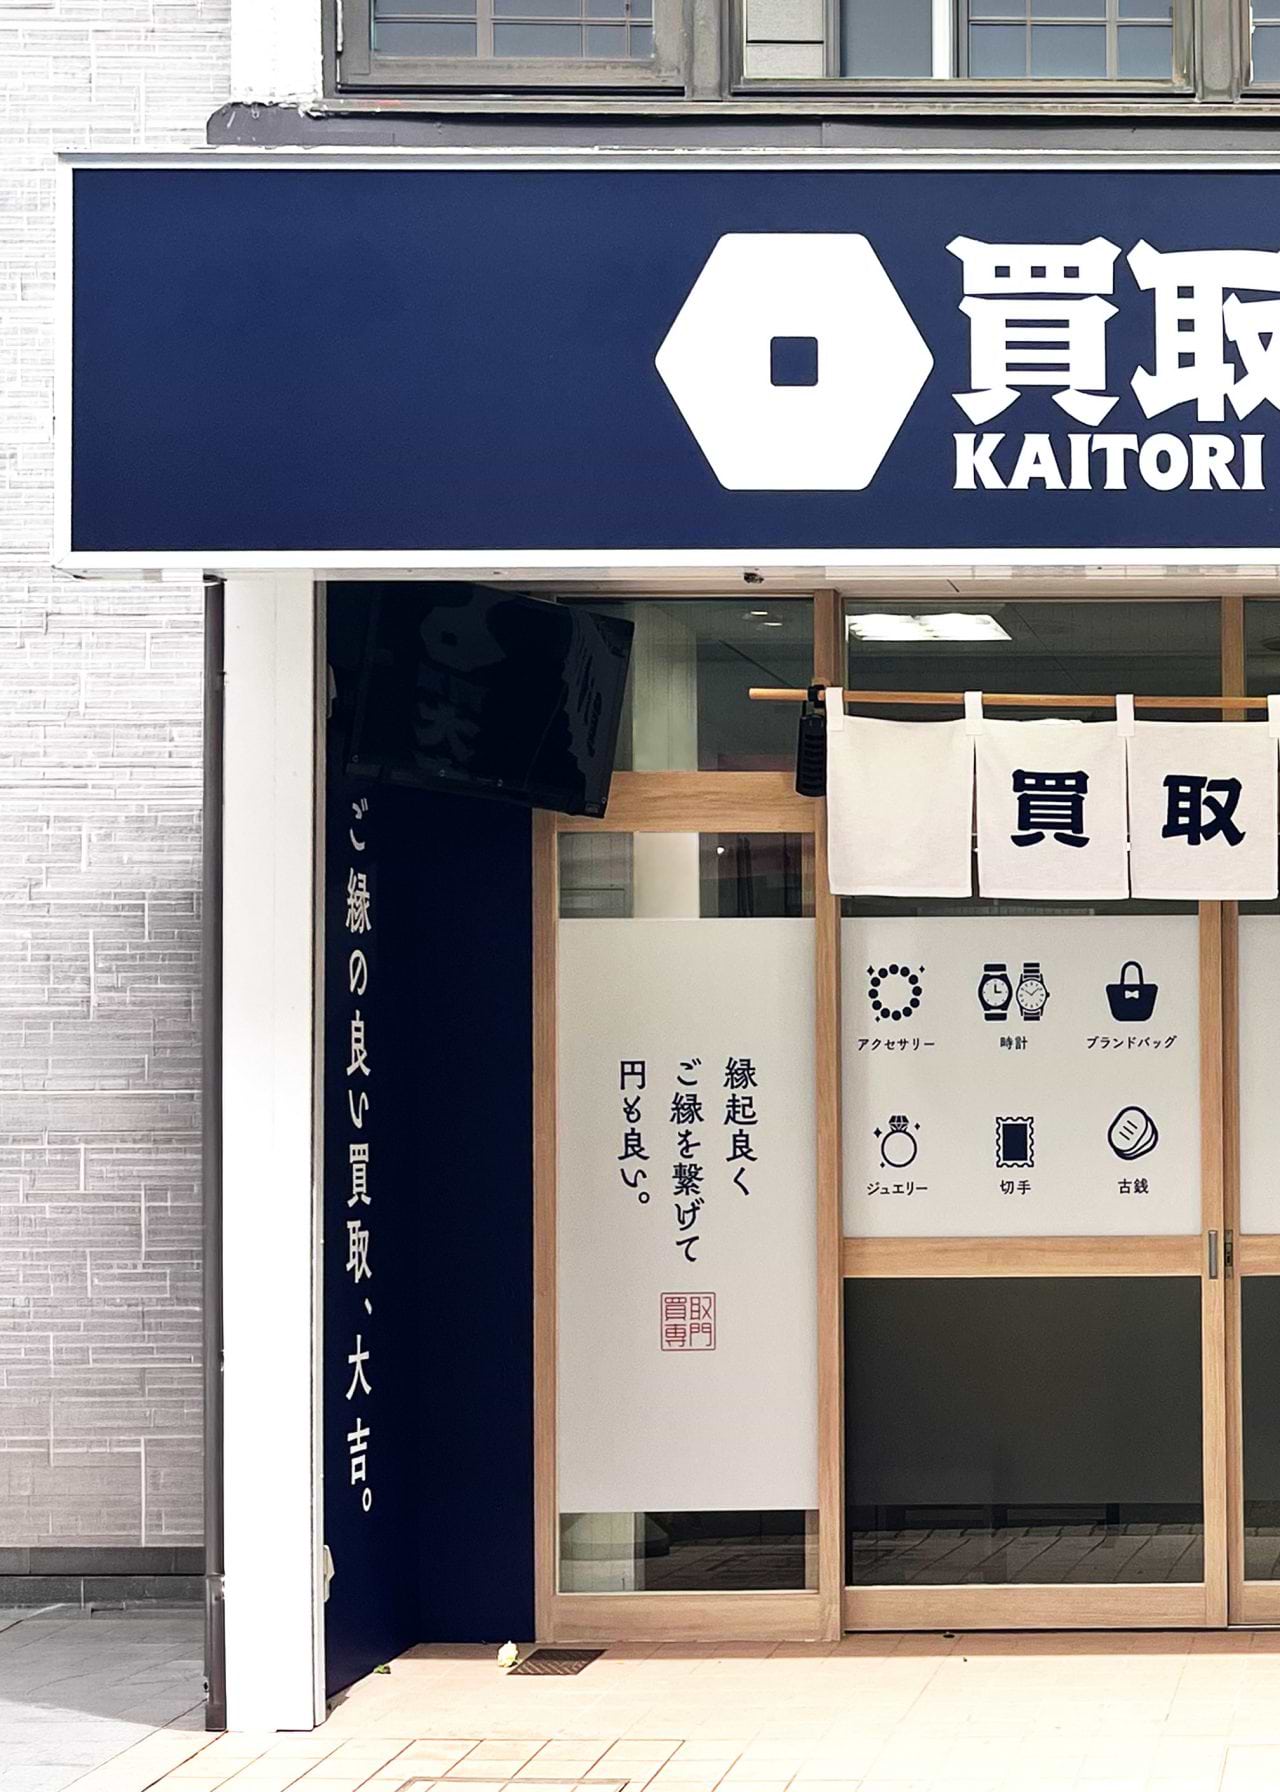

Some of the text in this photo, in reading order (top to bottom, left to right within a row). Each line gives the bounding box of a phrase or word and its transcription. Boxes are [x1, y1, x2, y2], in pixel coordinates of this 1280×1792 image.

[952, 432, 1266, 491] KAITORI
[857, 1038, 936, 1051] アクセサリー
[999, 1035, 1029, 1051] 時計
[1086, 1034, 1178, 1050] ブランドバッグ
[617, 1060, 651, 1205] 円も良い。
[722, 1056, 759, 1197] 縁起良く
[669, 1057, 705, 1263] ご縁を繋げて
[866, 1181, 929, 1196] ジュエリー
[999, 1179, 1033, 1196] 切手
[1117, 1177, 1150, 1195] 古銭
